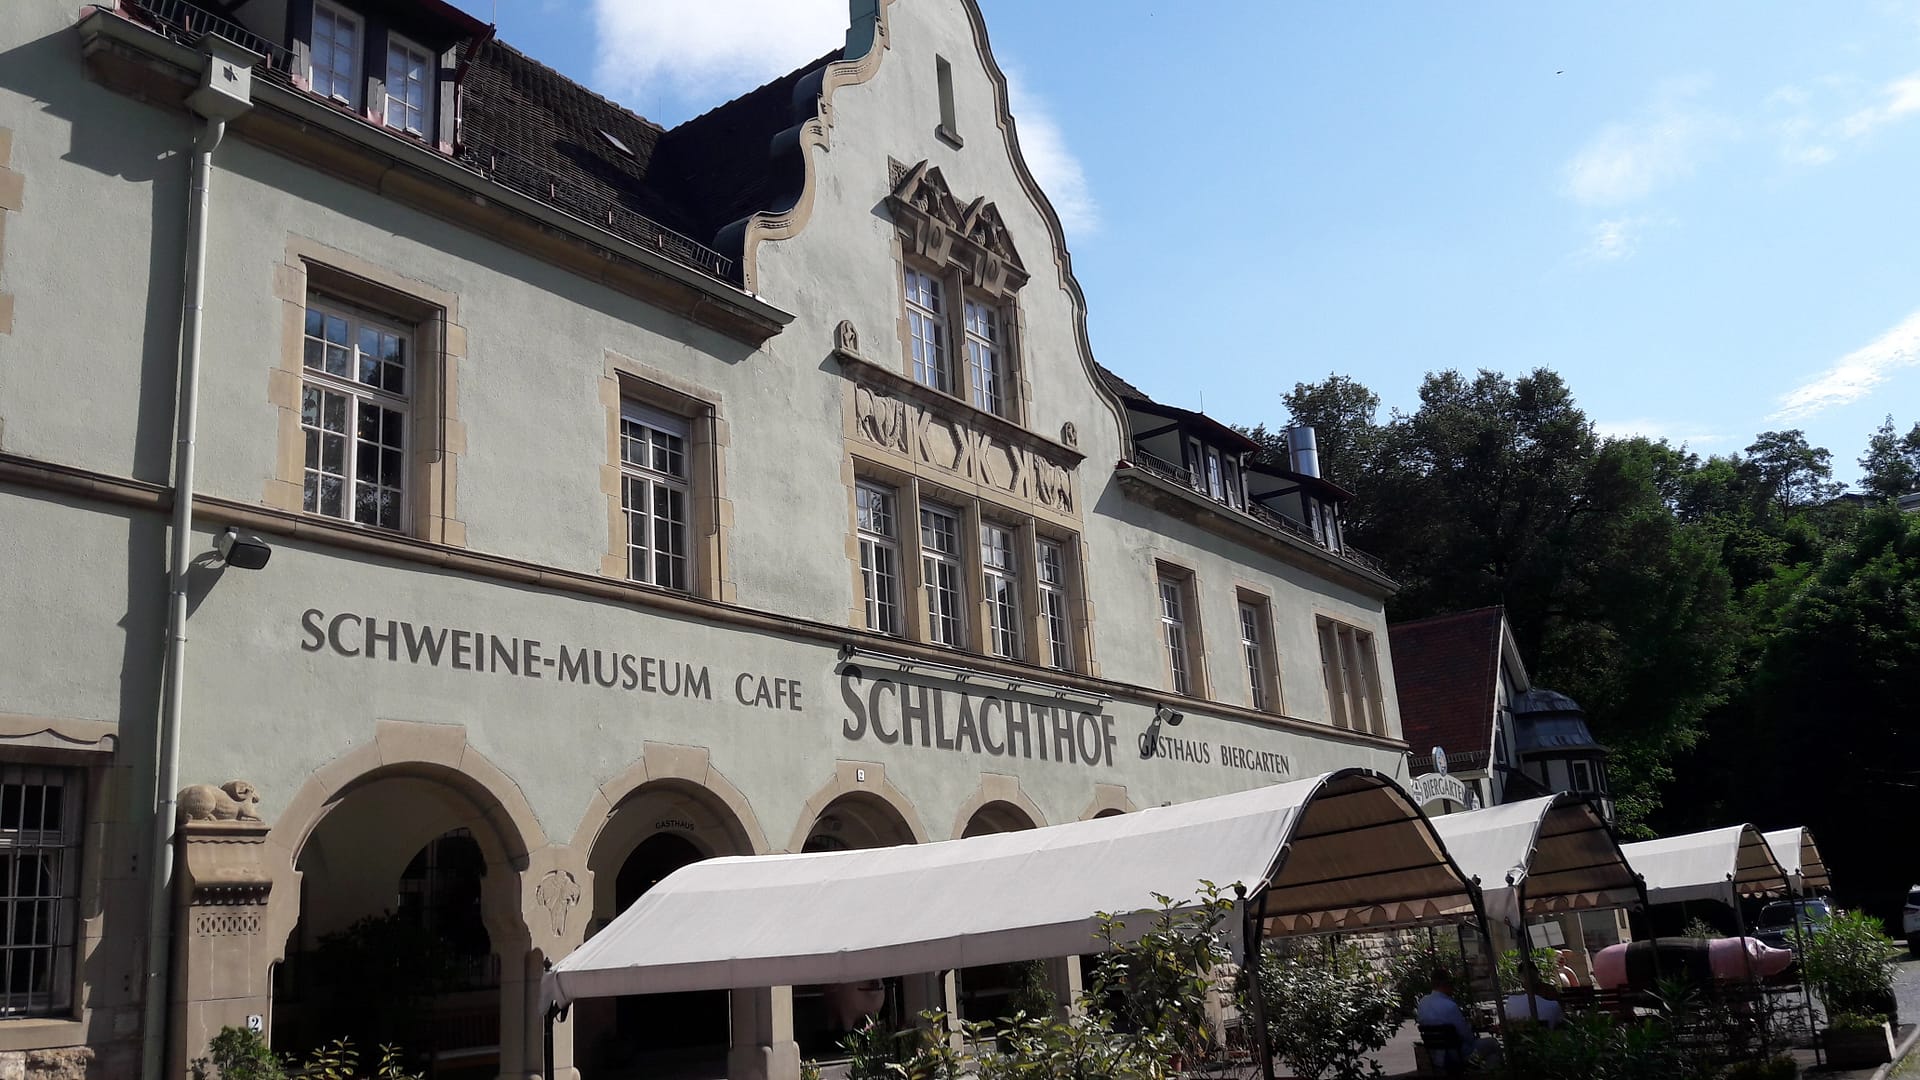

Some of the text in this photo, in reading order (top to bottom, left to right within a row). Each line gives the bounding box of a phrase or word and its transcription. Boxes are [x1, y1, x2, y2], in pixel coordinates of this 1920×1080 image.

[300, 609, 1290, 775] SCHWEINE-MUSEUM CAFE SCHLACHTHOF GASTHAUS BIERGARTEN
[655, 819, 695, 831] GASTHAUS
[251, 1016, 259, 1032] 2
